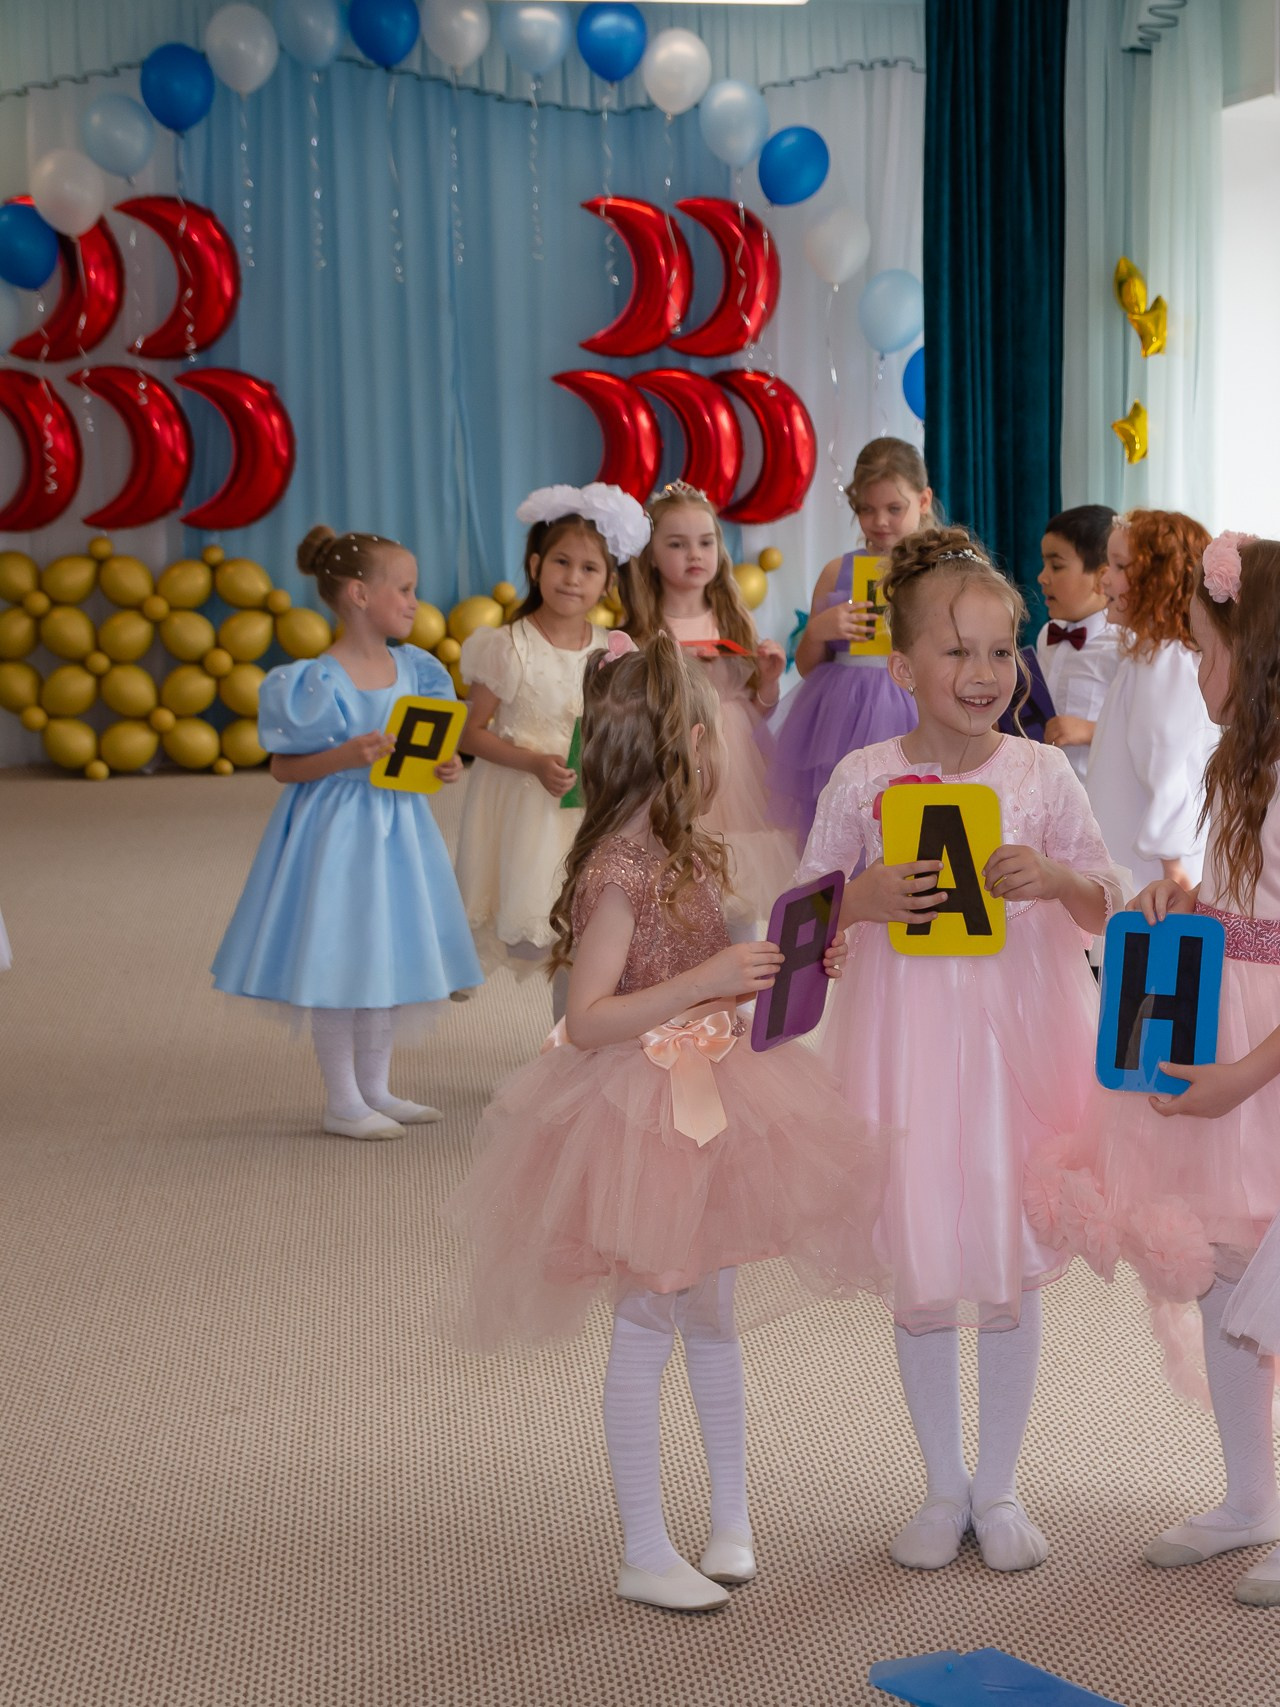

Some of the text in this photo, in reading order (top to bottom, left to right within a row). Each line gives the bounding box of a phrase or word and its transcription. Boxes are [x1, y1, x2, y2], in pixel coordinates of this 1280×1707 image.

[384, 706, 454, 778] Р
[906, 804, 993, 936] А
[766, 884, 835, 1041] Р
[1114, 931, 1204, 1071] Н
